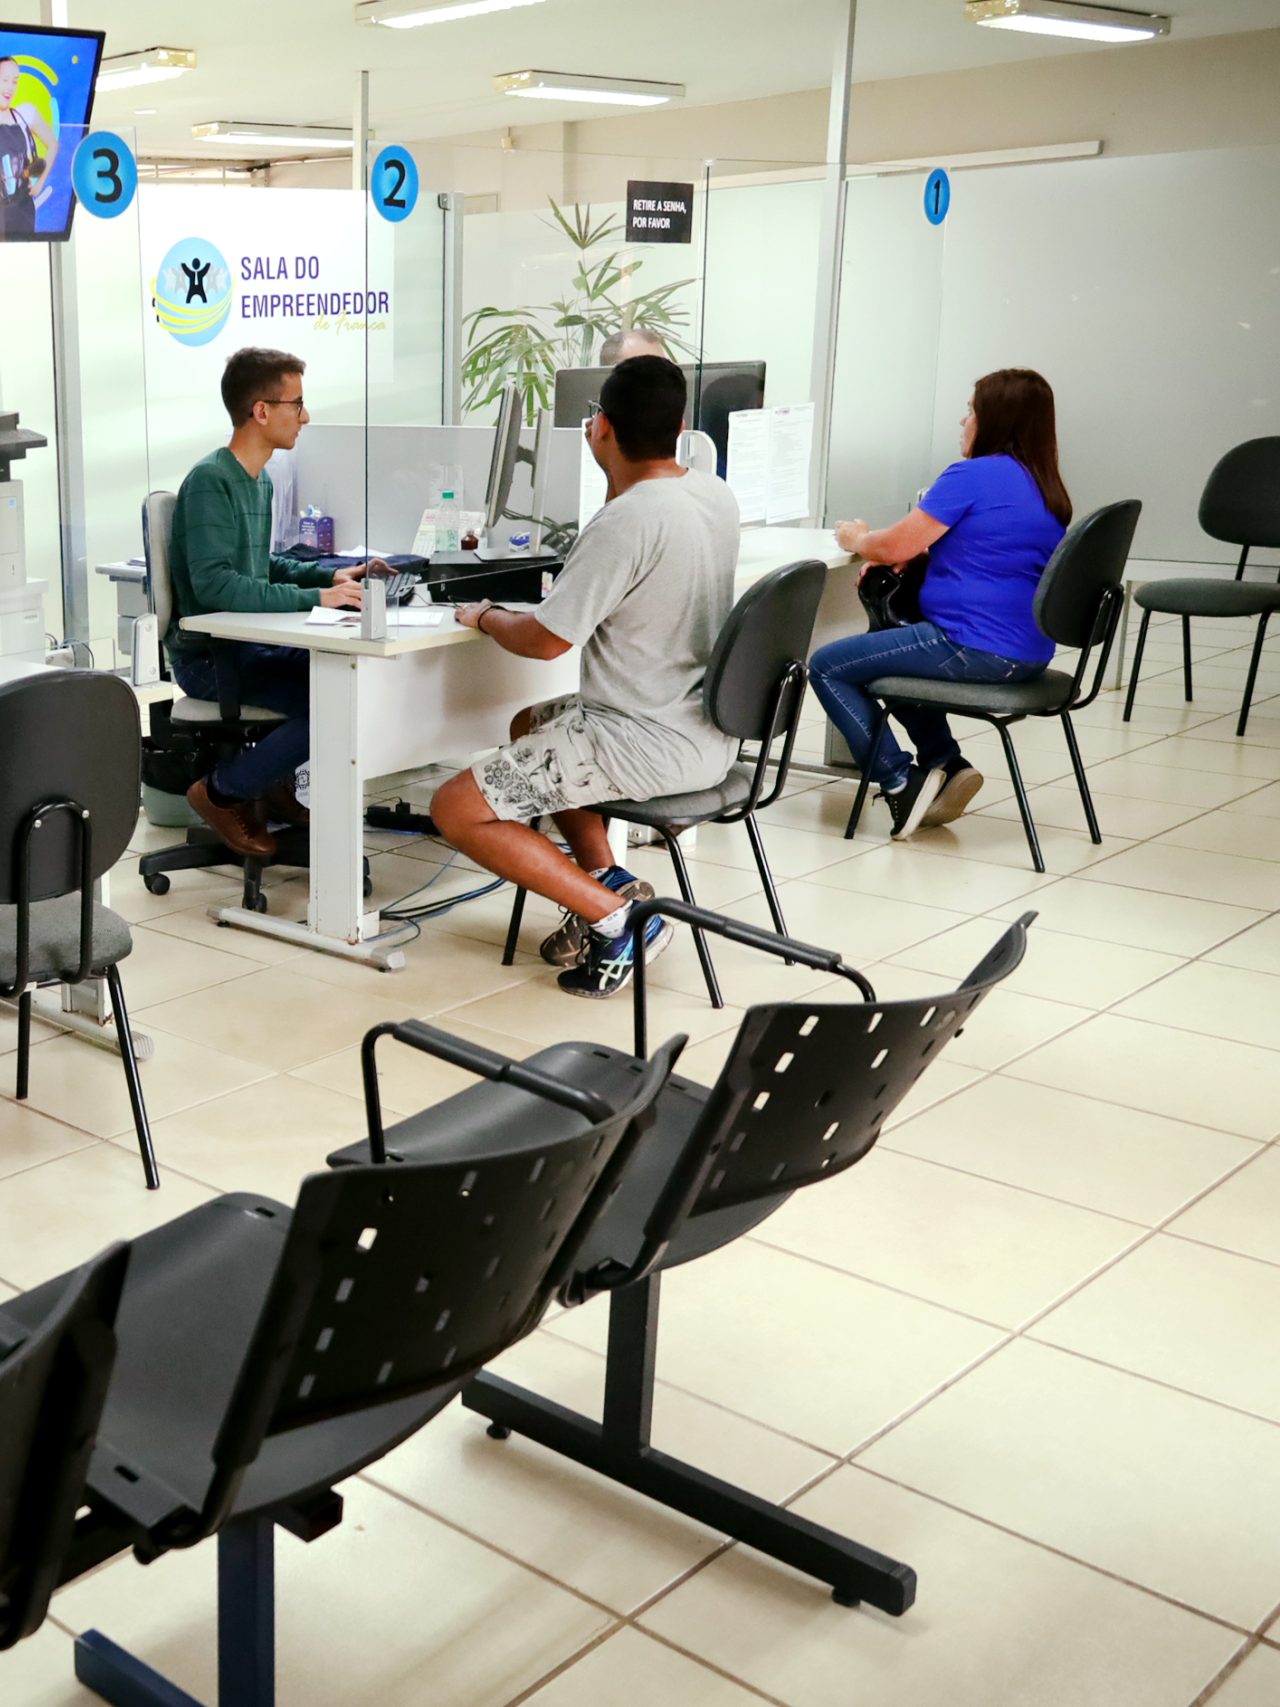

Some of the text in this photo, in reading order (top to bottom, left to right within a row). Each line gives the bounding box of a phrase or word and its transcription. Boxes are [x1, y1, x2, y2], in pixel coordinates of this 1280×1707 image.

[92, 147, 123, 203] 3
[383, 158, 406, 209] 2
[633, 199, 687, 215] RETIRE A SENHA,
[933, 179, 941, 215] 1
[632, 216, 671, 229] POR FAVOR
[240, 255, 320, 281] SALA DO
[241, 291, 390, 319] EMPREENDEDOR
